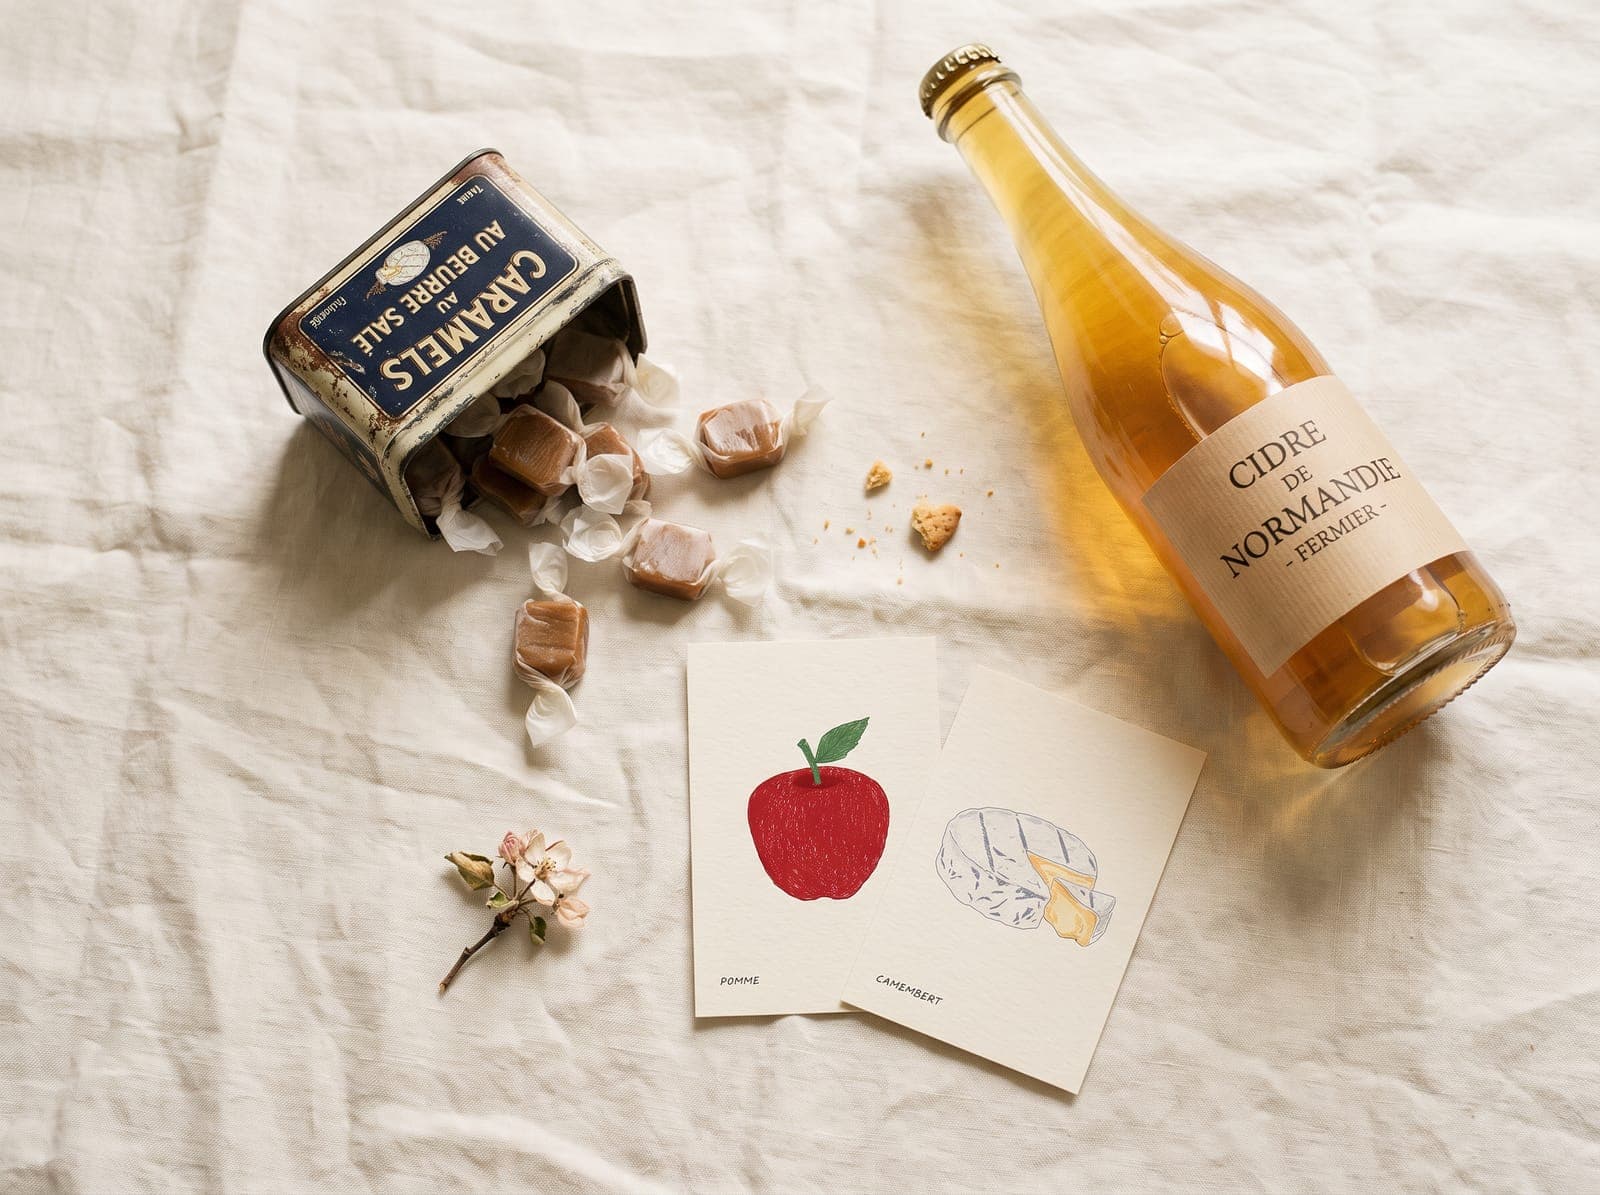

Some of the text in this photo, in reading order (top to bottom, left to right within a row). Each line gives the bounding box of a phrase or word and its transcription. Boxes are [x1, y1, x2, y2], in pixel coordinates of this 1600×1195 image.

[473, 219, 507, 253] AU
[400, 244, 481, 315] BEURRE
[436, 290, 459, 314] AU
[350, 306, 405, 357] SALÉ
[379, 249, 548, 391] CARAMELS
[1228, 419, 1327, 489] CIDRE
[1281, 465, 1313, 492] DE
[1219, 456, 1401, 579] NORMANDIE
[1293, 504, 1380, 563] FERMIER
[719, 975, 760, 986] POMME
[875, 974, 943, 1006] CAMEMBERT
